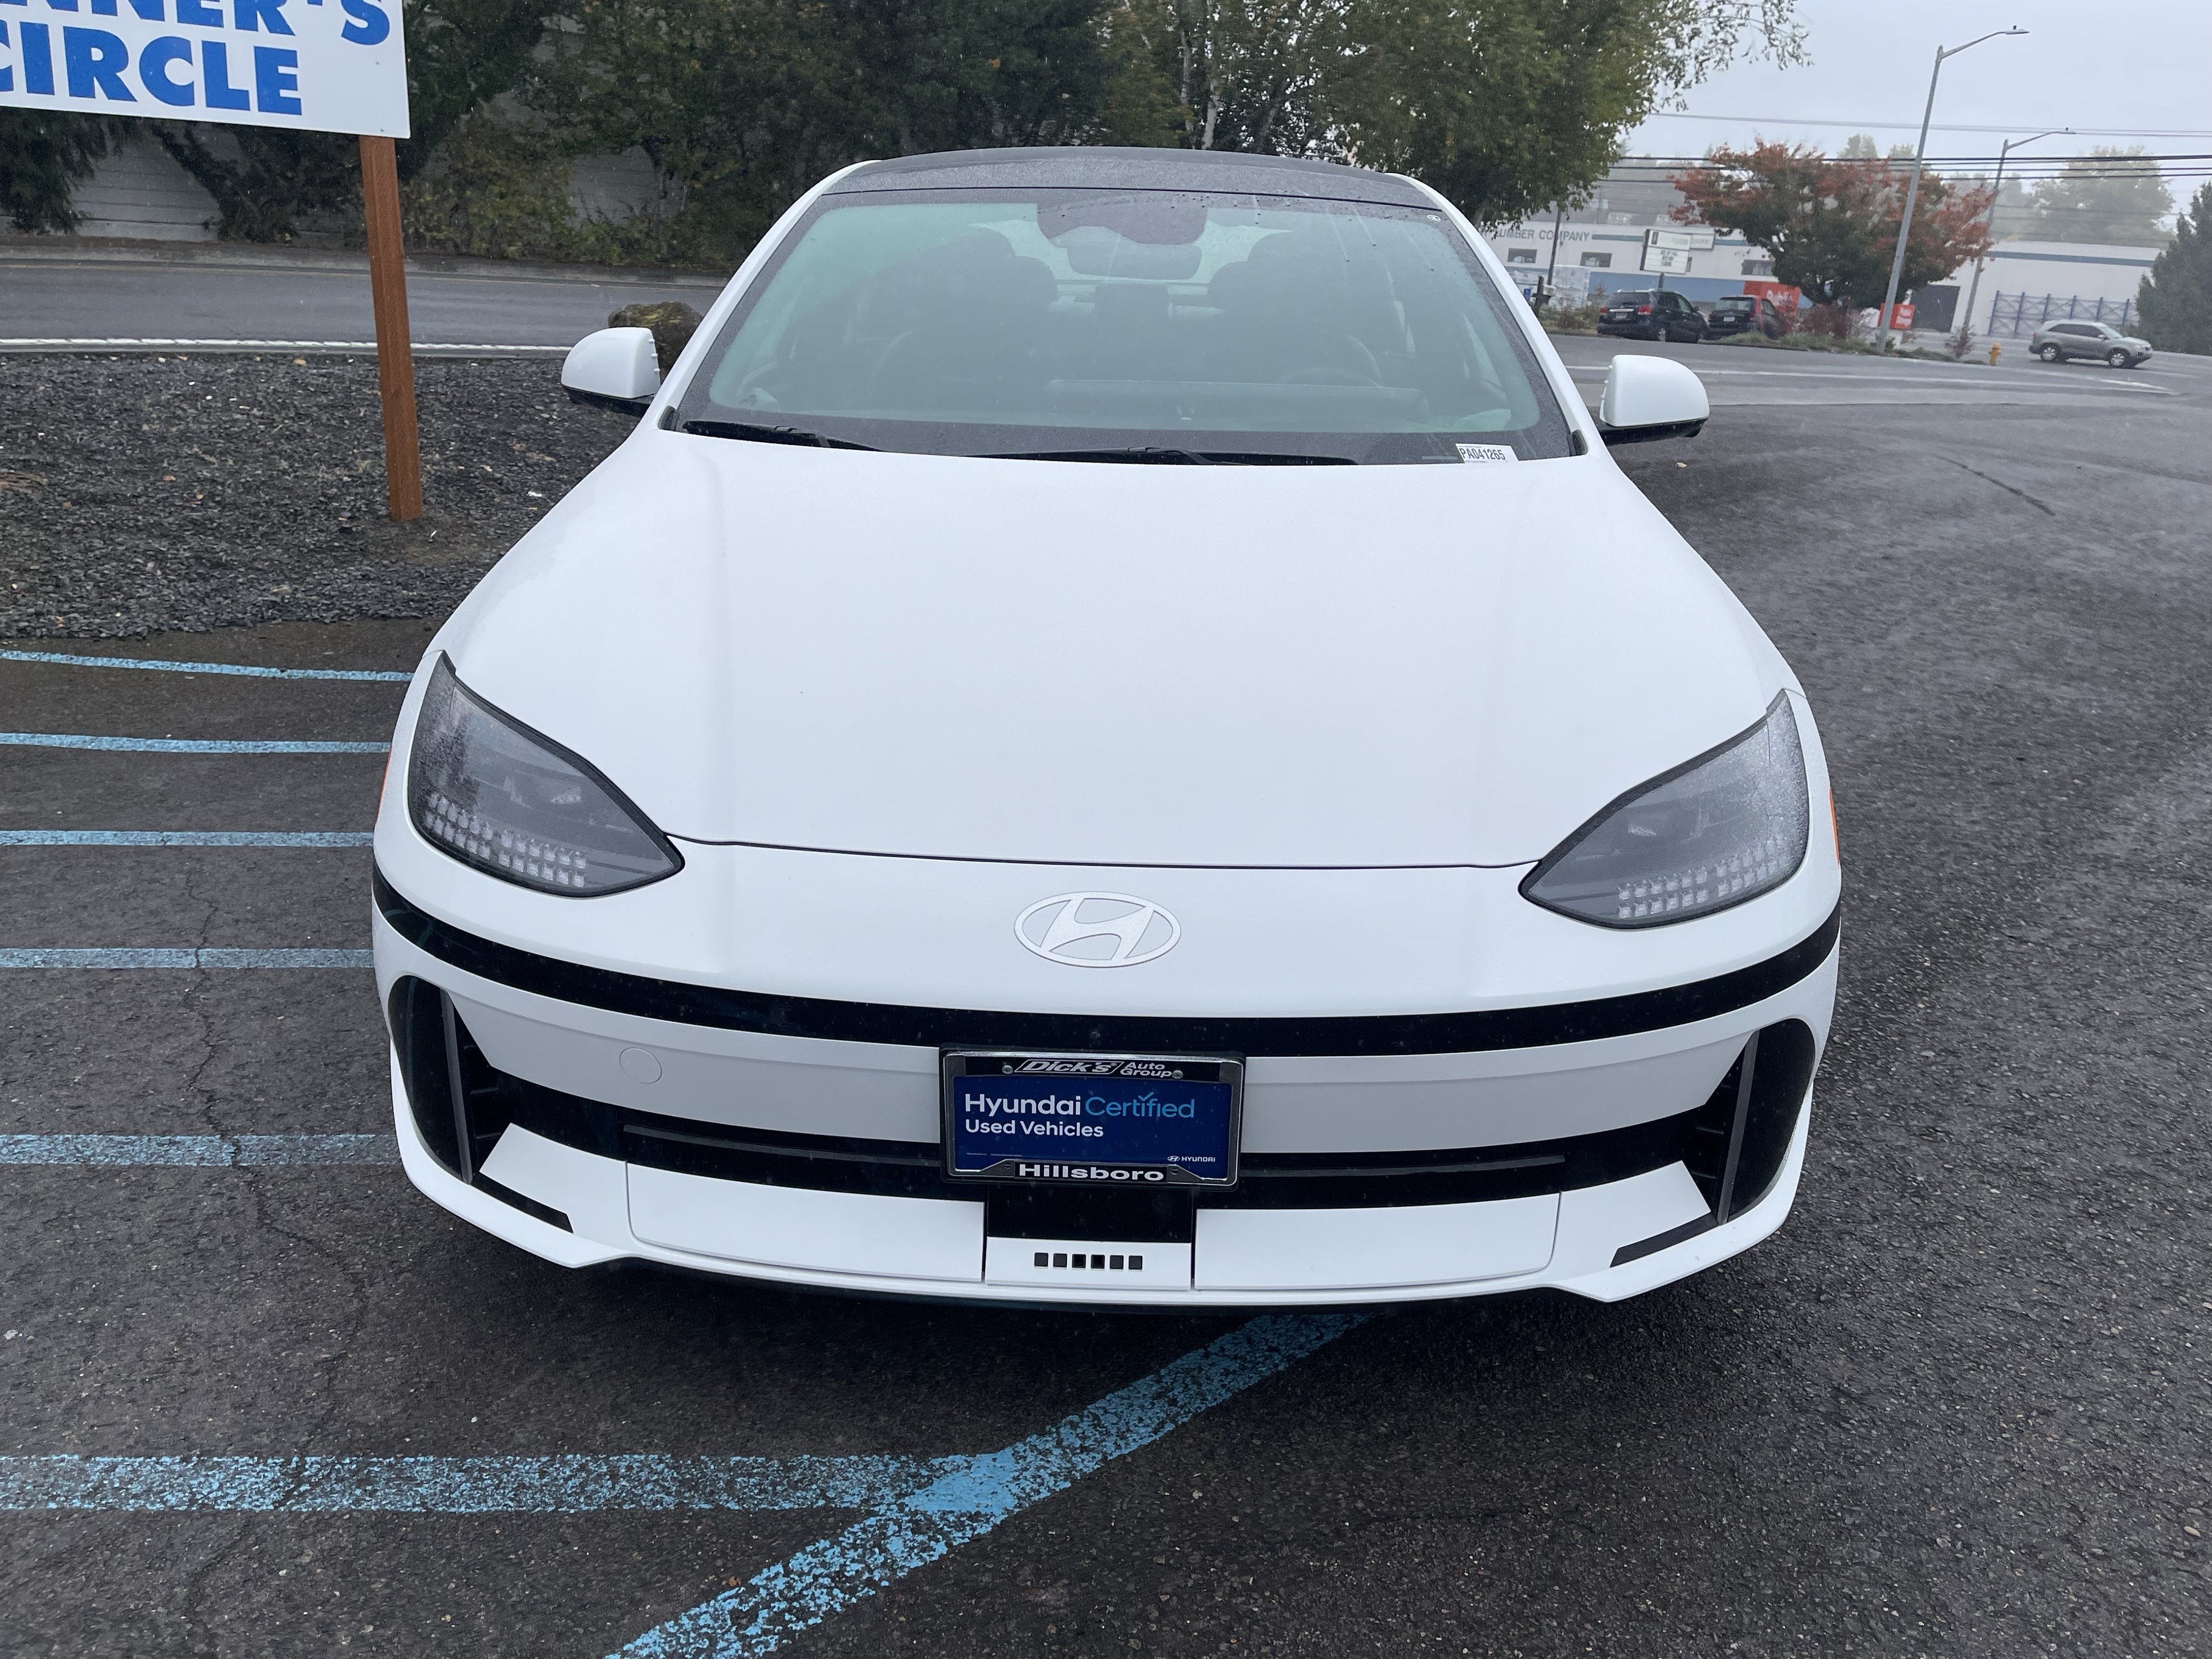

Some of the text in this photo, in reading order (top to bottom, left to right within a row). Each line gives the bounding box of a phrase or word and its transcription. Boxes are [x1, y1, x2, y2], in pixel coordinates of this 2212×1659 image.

[0, 20, 302, 116] IRCLE
[1459, 448, 1506, 460] PA041265
[1120, 1068, 1172, 1078] Group
[1125, 1062, 1165, 1070] Auto
[965, 1093, 1195, 1118] Hyundai Certified
[966, 1119, 1104, 1137] Used Vehicles
[1019, 1164, 1164, 1181] Hillsboro
